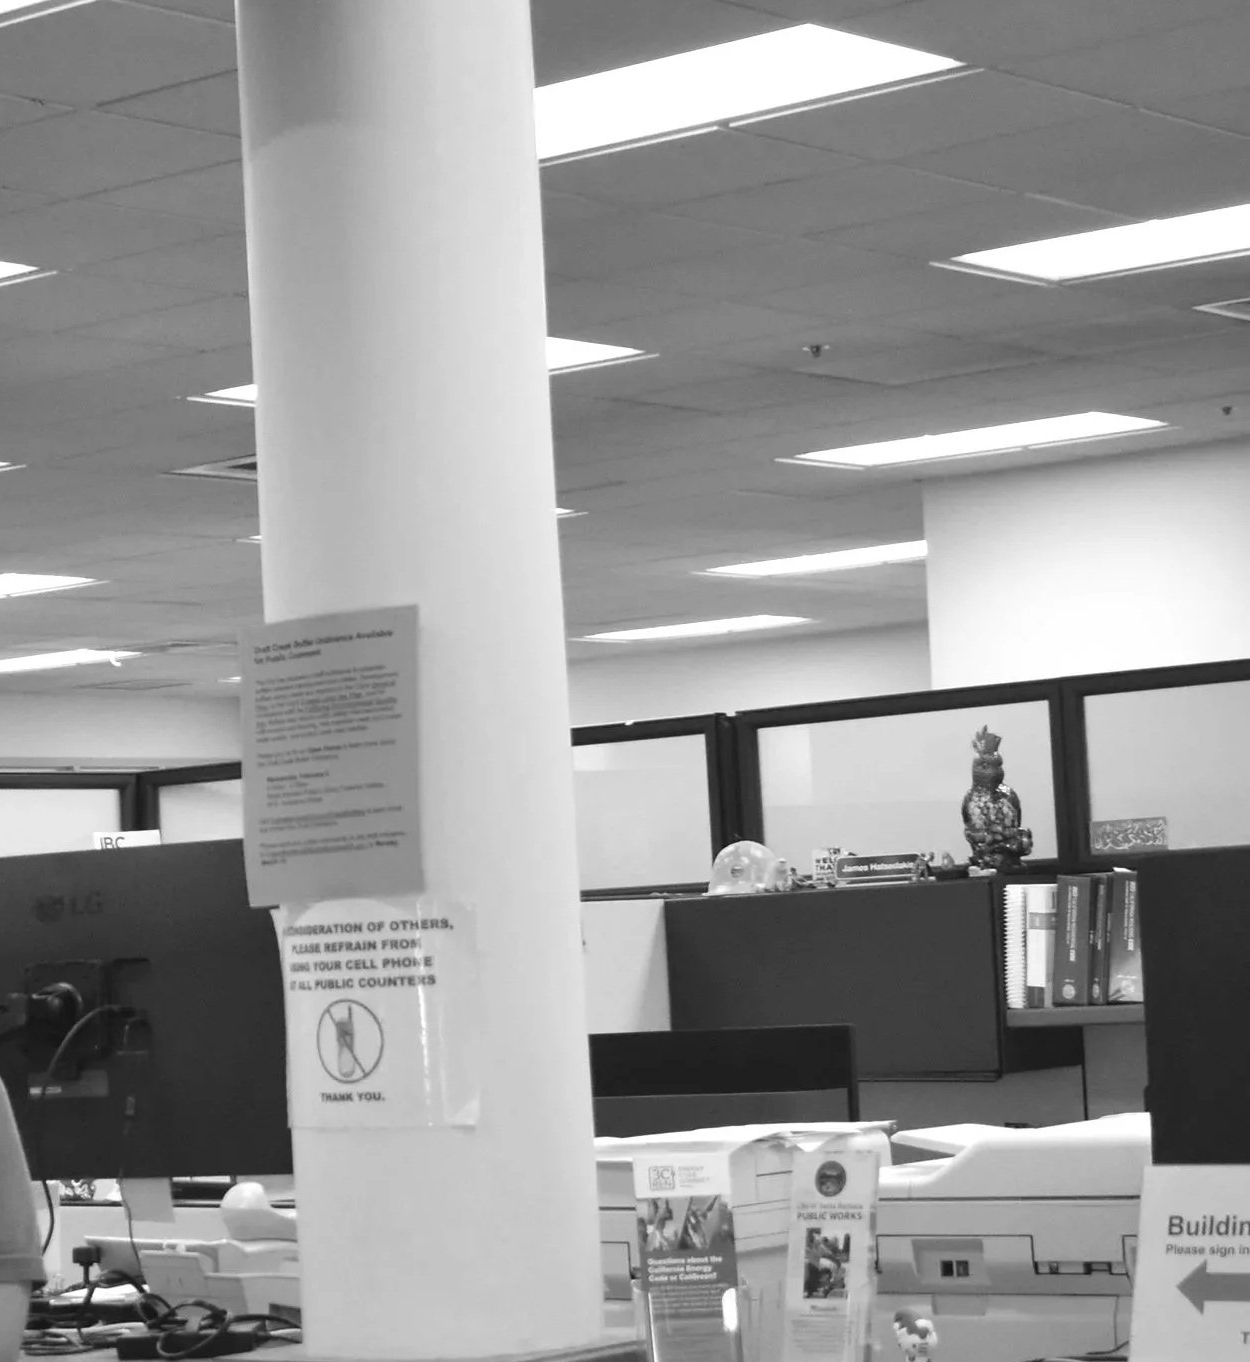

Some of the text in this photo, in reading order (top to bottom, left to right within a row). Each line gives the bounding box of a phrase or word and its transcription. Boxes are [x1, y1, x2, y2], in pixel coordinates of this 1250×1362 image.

[356, 630, 394, 640] Available
[842, 864, 869, 872] James
[71, 892, 102, 914] LG
[367, 920, 385, 932] OF
[390, 918, 454, 932] OTHERS,
[292, 938, 422, 954] PLEASE REFRAIN FROM
[313, 960, 342, 971] YOUR
[346, 958, 378, 970] CELL
[314, 978, 355, 990] PUBLIC
[358, 974, 436, 988] COUNTERS
[320, 1091, 386, 1103] THANK YOU.
[797, 1211, 862, 1220] PUBLIC WORKS
[1166, 1244, 1205, 1255] Please
[1209, 1244, 1235, 1257] sign
[648, 1265, 685, 1273] California
